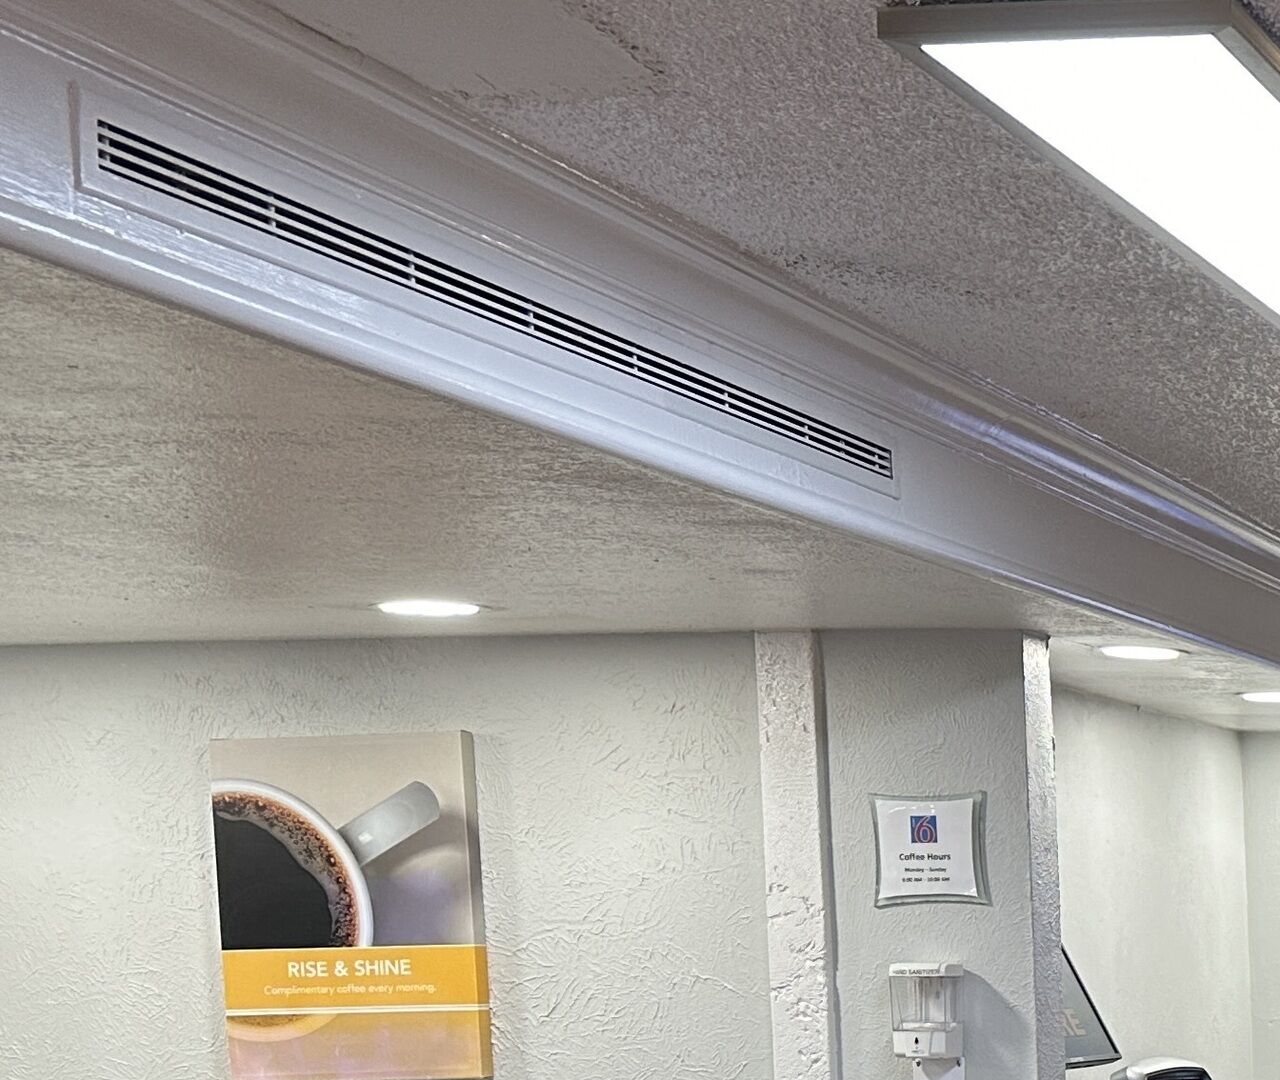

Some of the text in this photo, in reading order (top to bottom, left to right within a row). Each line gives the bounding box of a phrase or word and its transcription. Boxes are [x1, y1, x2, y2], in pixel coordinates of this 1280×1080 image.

[899, 853, 951, 861] Coffee Hours
[287, 958, 412, 978] RISE & SHINE
[263, 983, 437, 998] Complimentary coffee every morning.
